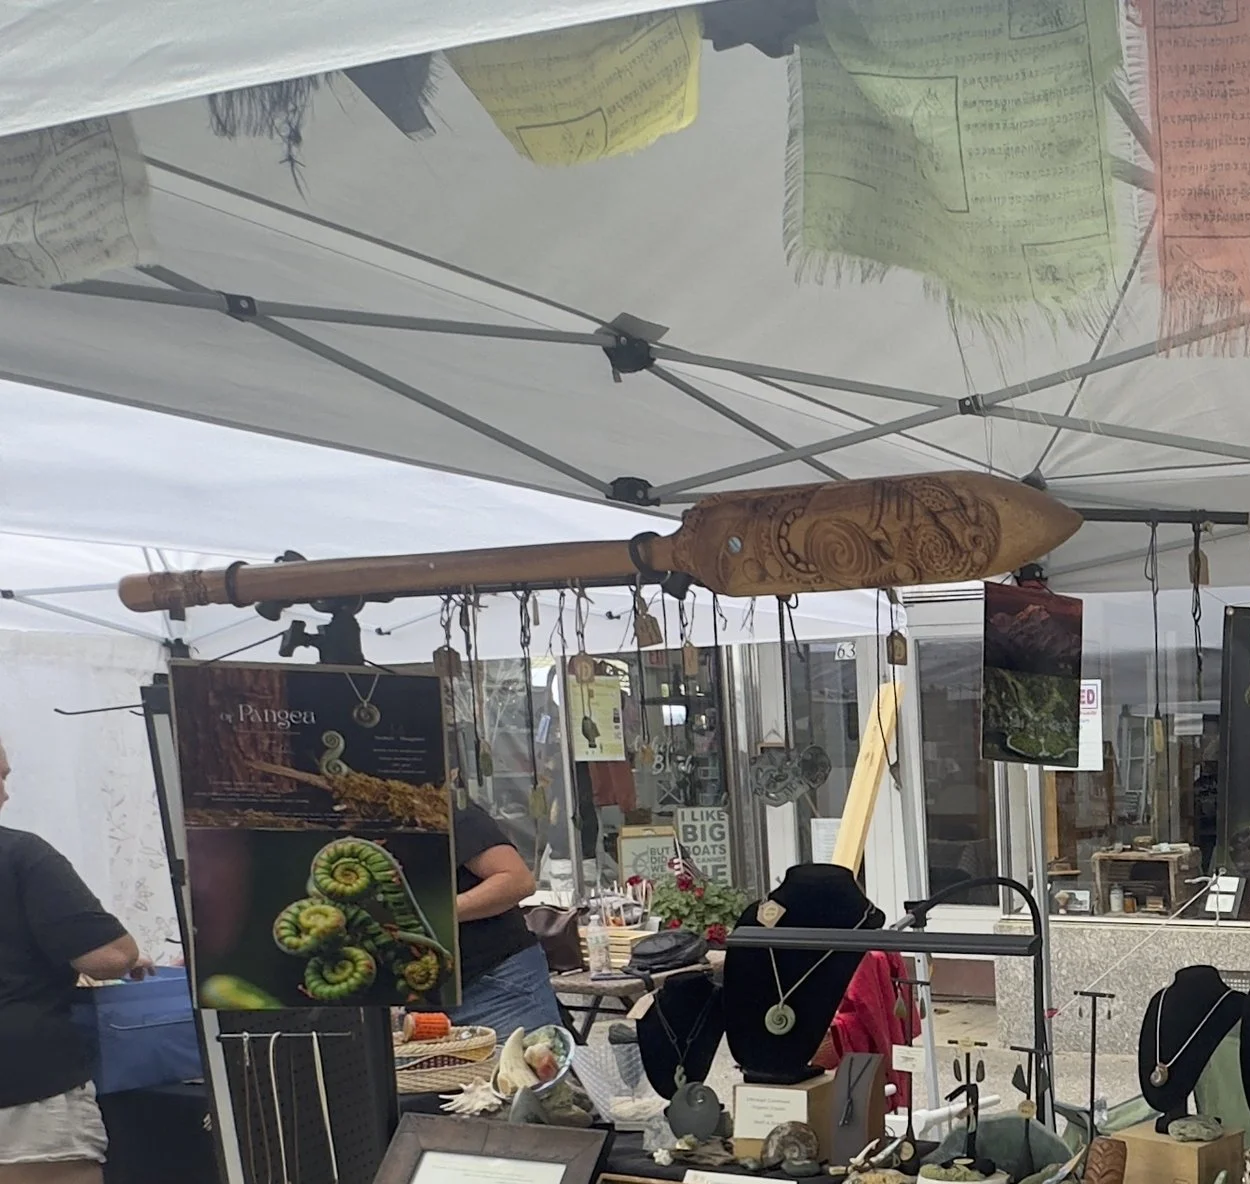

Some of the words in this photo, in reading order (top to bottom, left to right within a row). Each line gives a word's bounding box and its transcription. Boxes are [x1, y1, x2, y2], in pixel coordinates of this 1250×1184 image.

[837, 642, 856, 659] 63
[238, 703, 316, 729] Pangea
[681, 811, 685, 822] I
[691, 810, 726, 822] LIKE
[682, 823, 726, 843] BIG
[650, 847, 670, 856] BUT
